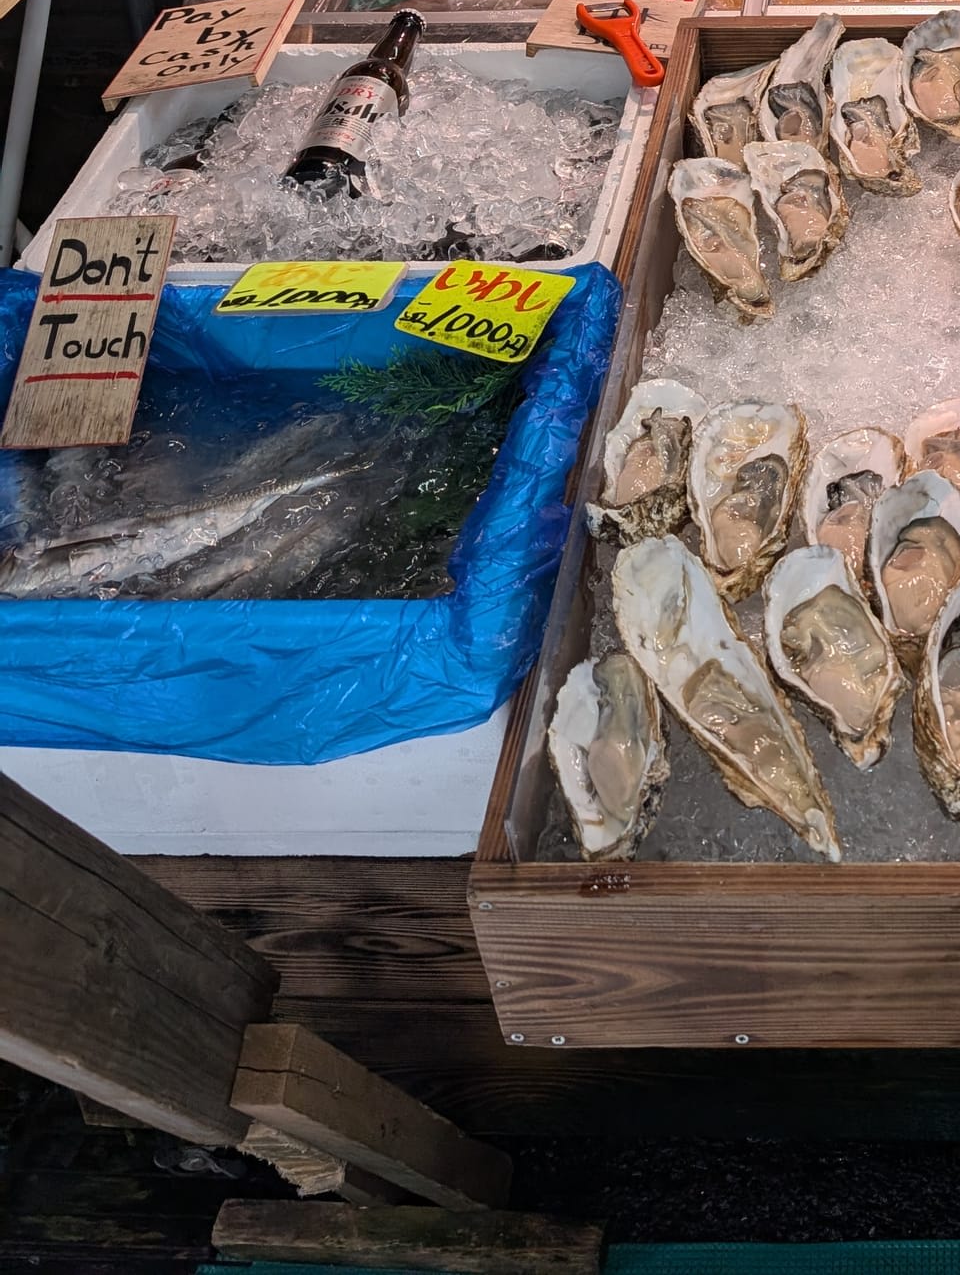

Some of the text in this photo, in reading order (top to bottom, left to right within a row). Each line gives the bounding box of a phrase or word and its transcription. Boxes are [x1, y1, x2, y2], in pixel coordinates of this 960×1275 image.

[153, 7, 247, 32] Pay
[195, 26, 268, 48] by
[336, 86, 376, 100] DRY
[49, 232, 160, 288] Don't
[434, 267, 551, 312] いわし
[39, 311, 147, 360] Touch
